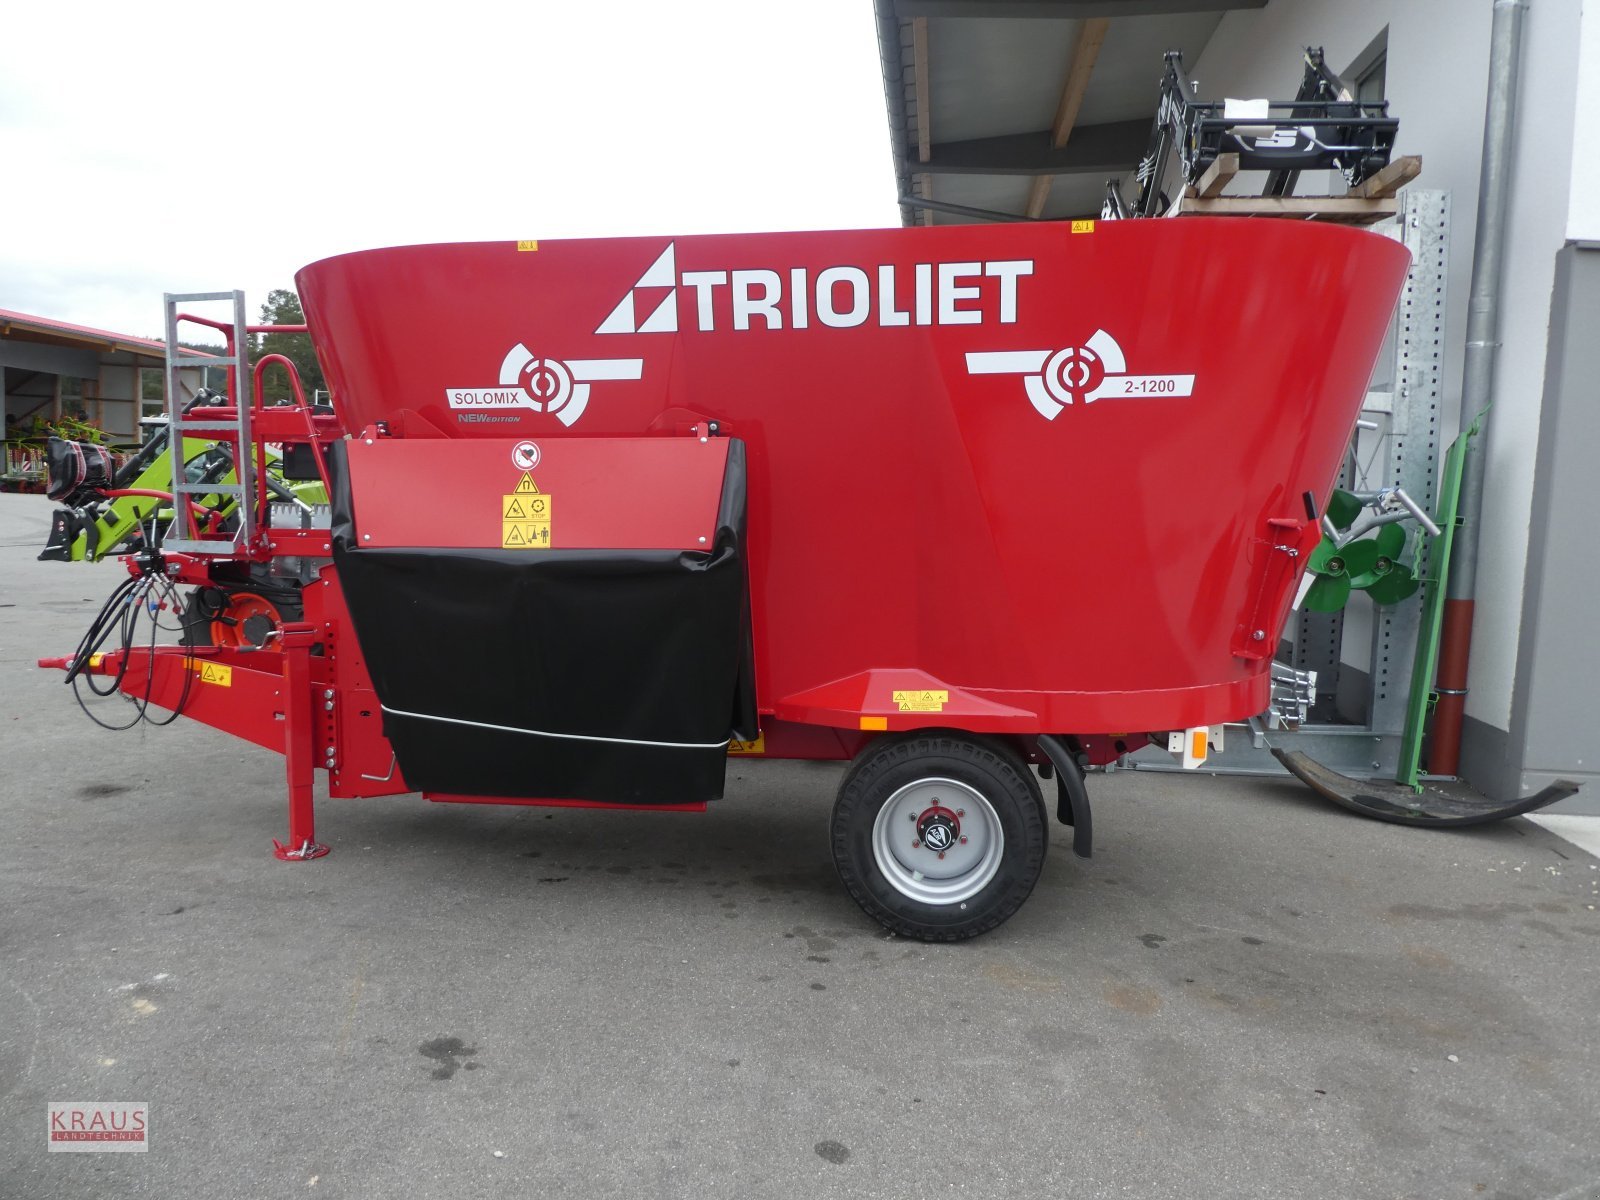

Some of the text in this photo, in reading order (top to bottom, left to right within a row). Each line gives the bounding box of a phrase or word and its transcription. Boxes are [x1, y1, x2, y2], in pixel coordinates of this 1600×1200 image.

[682, 259, 1034, 331] TRIOLIET
[1124, 379, 1175, 393] 2-1200
[455, 392, 519, 405] SOLOMIX
